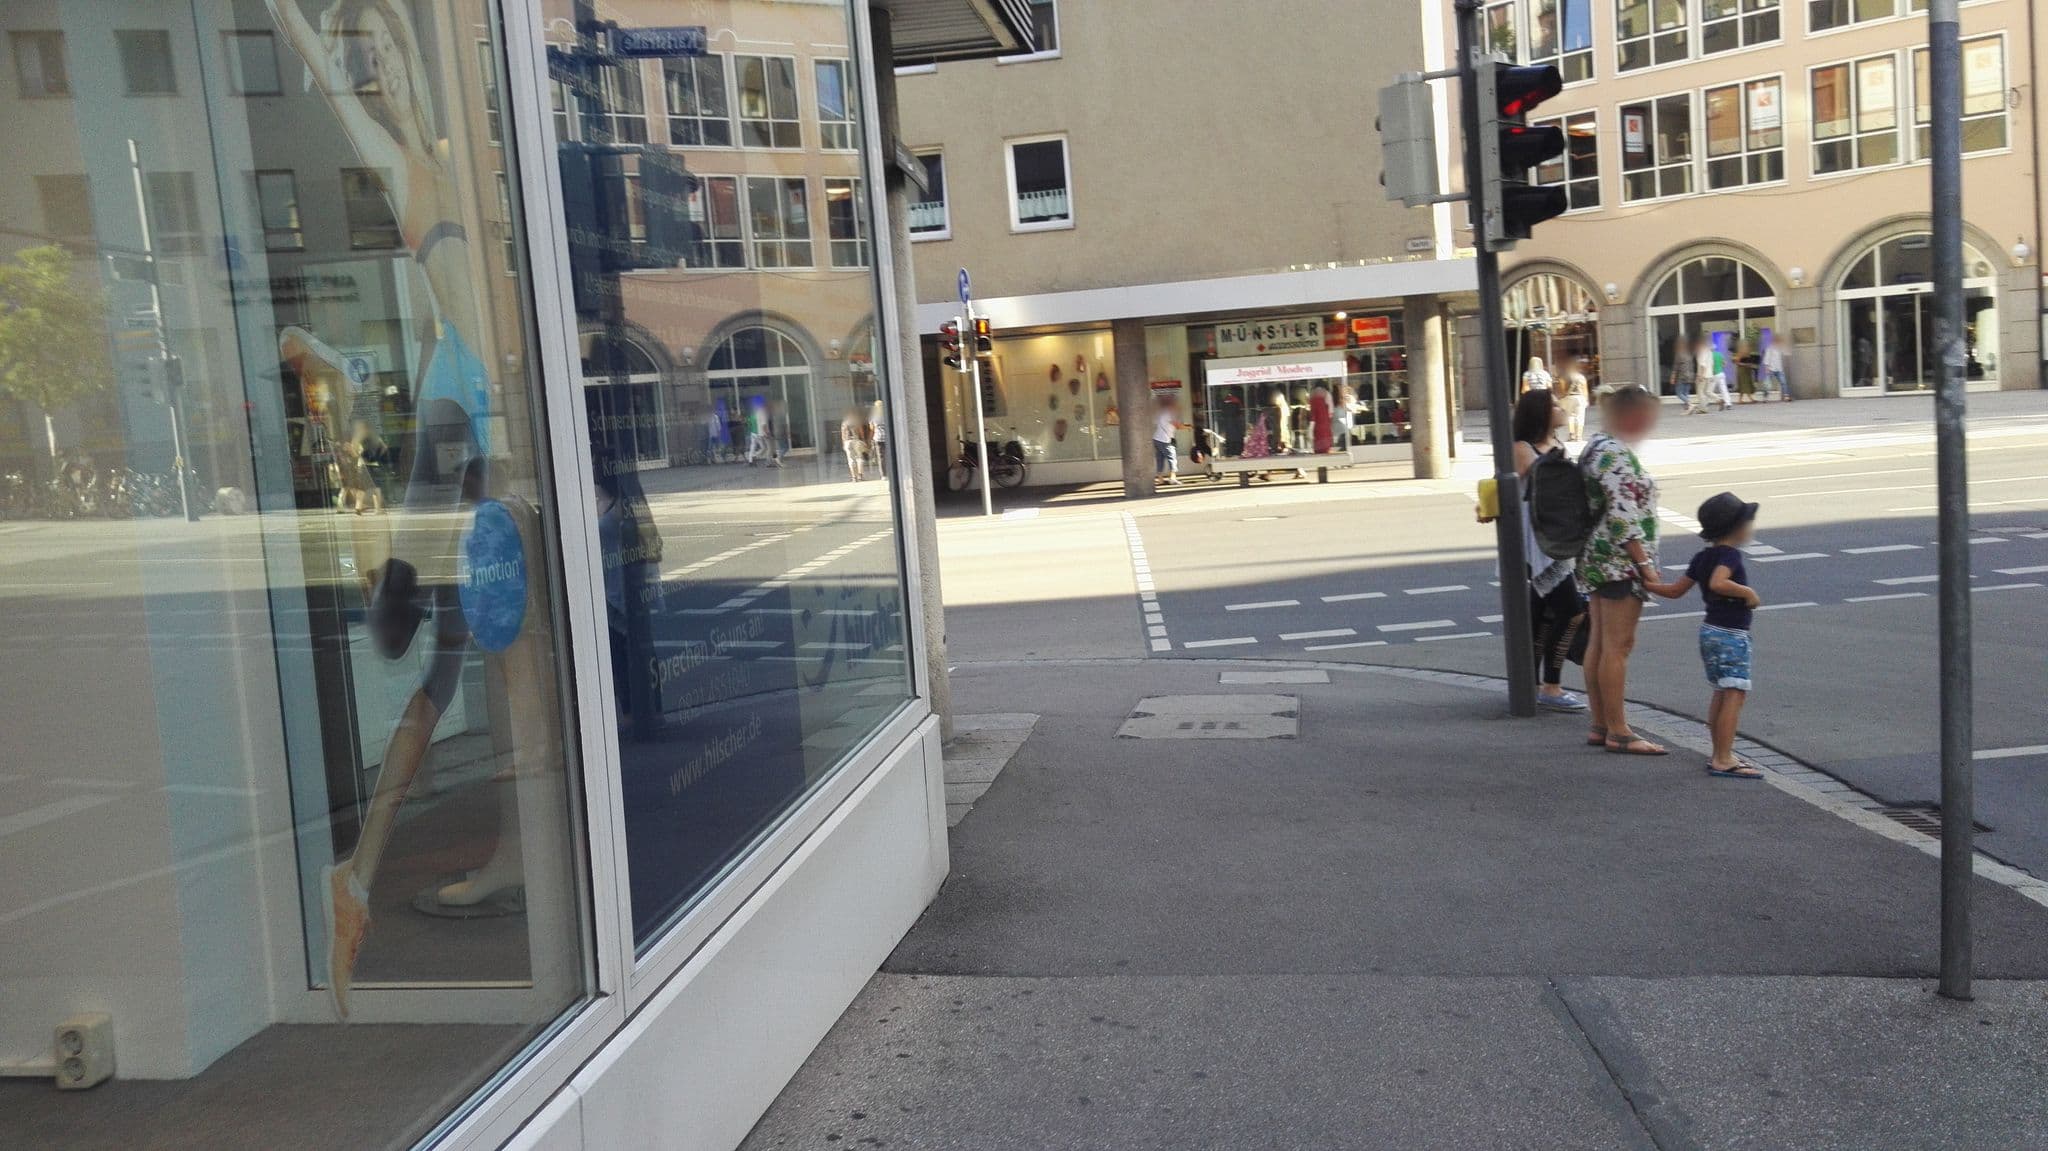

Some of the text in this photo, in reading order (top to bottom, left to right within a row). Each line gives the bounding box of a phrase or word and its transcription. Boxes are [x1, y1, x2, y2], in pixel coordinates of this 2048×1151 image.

[649, 641, 708, 692] Sprechen
[709, 627, 728, 656] Sie
[729, 624, 746, 648] uns
[669, 712, 762, 797] www.hilscher.de
